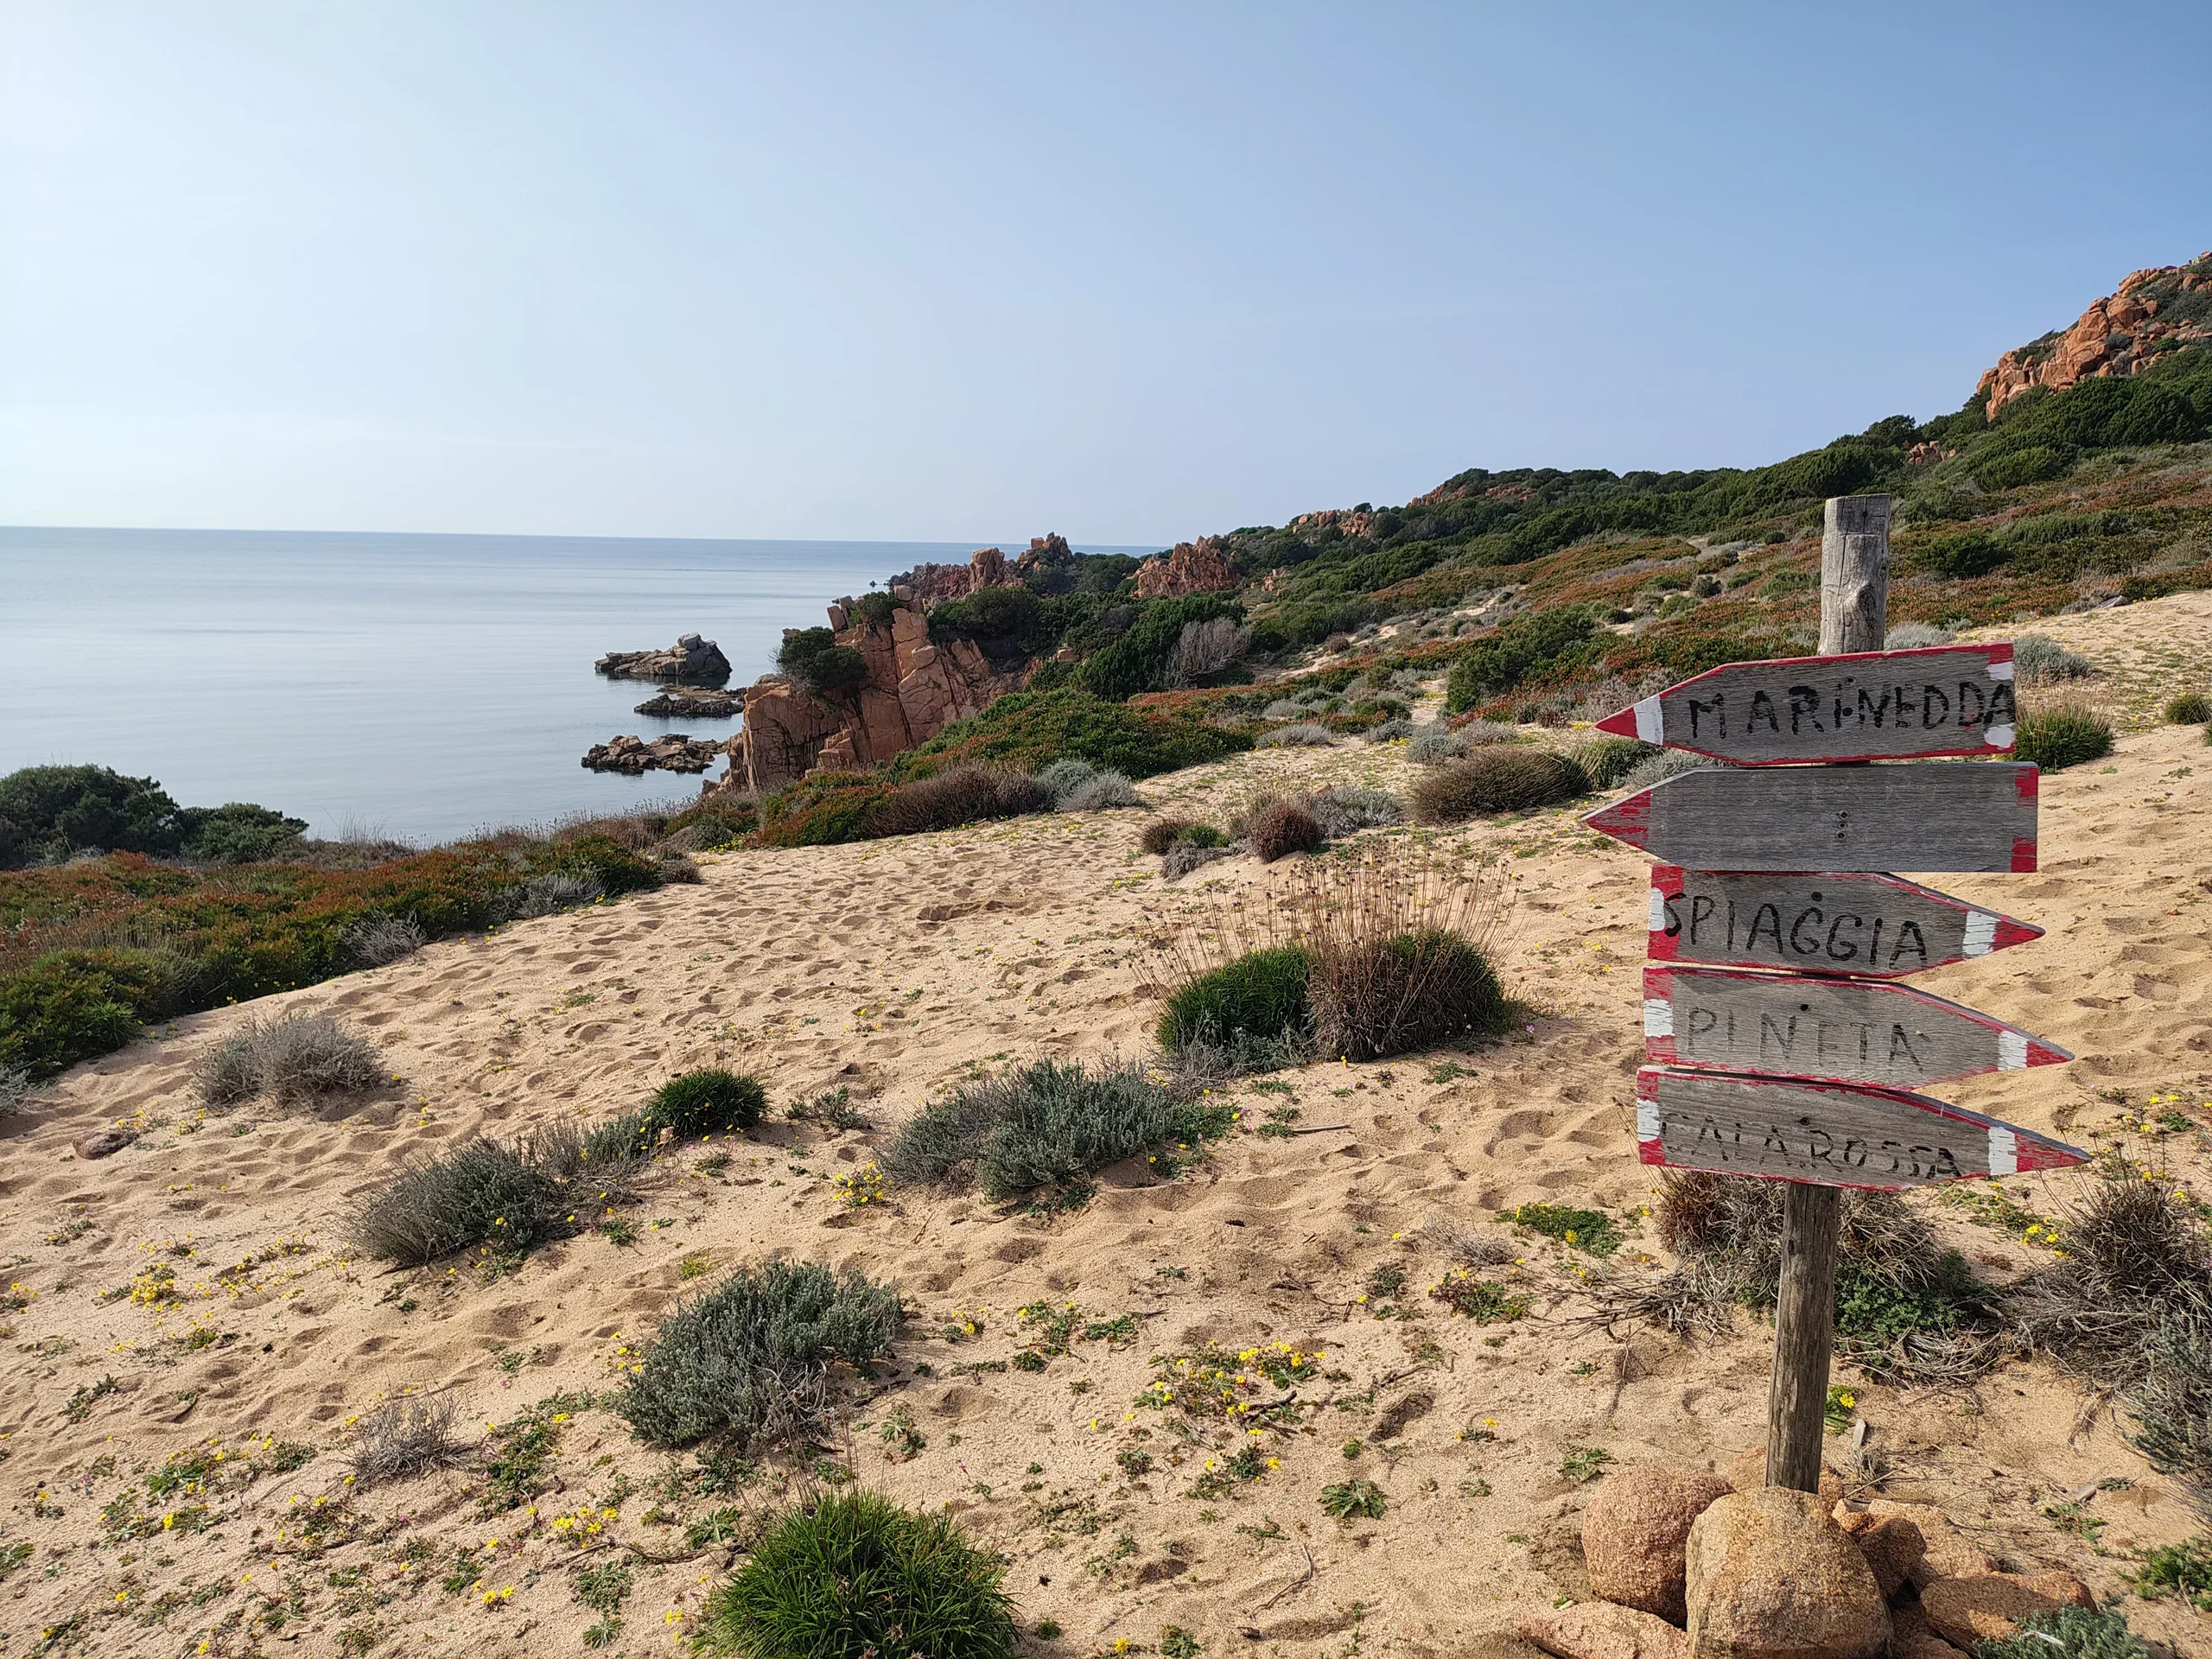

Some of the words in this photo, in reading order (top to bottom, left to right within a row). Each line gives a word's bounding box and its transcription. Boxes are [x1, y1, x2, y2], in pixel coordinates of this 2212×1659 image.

[1688, 681, 2014, 740] MARINEDDA
[1663, 892, 1928, 969] SPIAGGIA
[1688, 1006, 1924, 1075] PINETA
[1808, 1128, 1962, 1179] ROSSA
